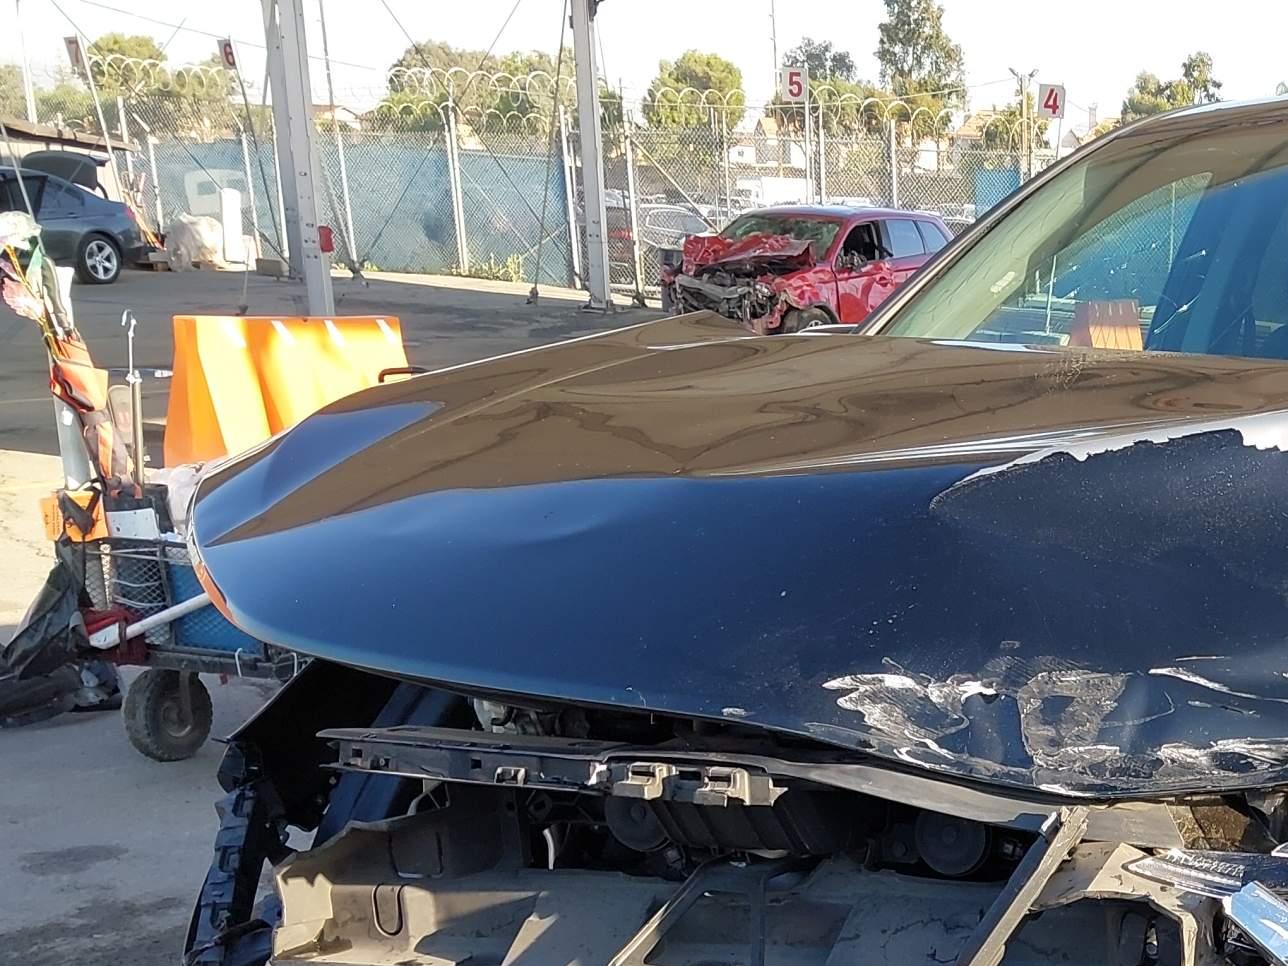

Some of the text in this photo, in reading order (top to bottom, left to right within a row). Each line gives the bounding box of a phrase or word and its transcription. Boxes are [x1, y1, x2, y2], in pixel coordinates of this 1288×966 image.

[223, 43, 236, 66] 6
[788, 71, 803, 97] 5
[1043, 88, 1060, 114] 4
